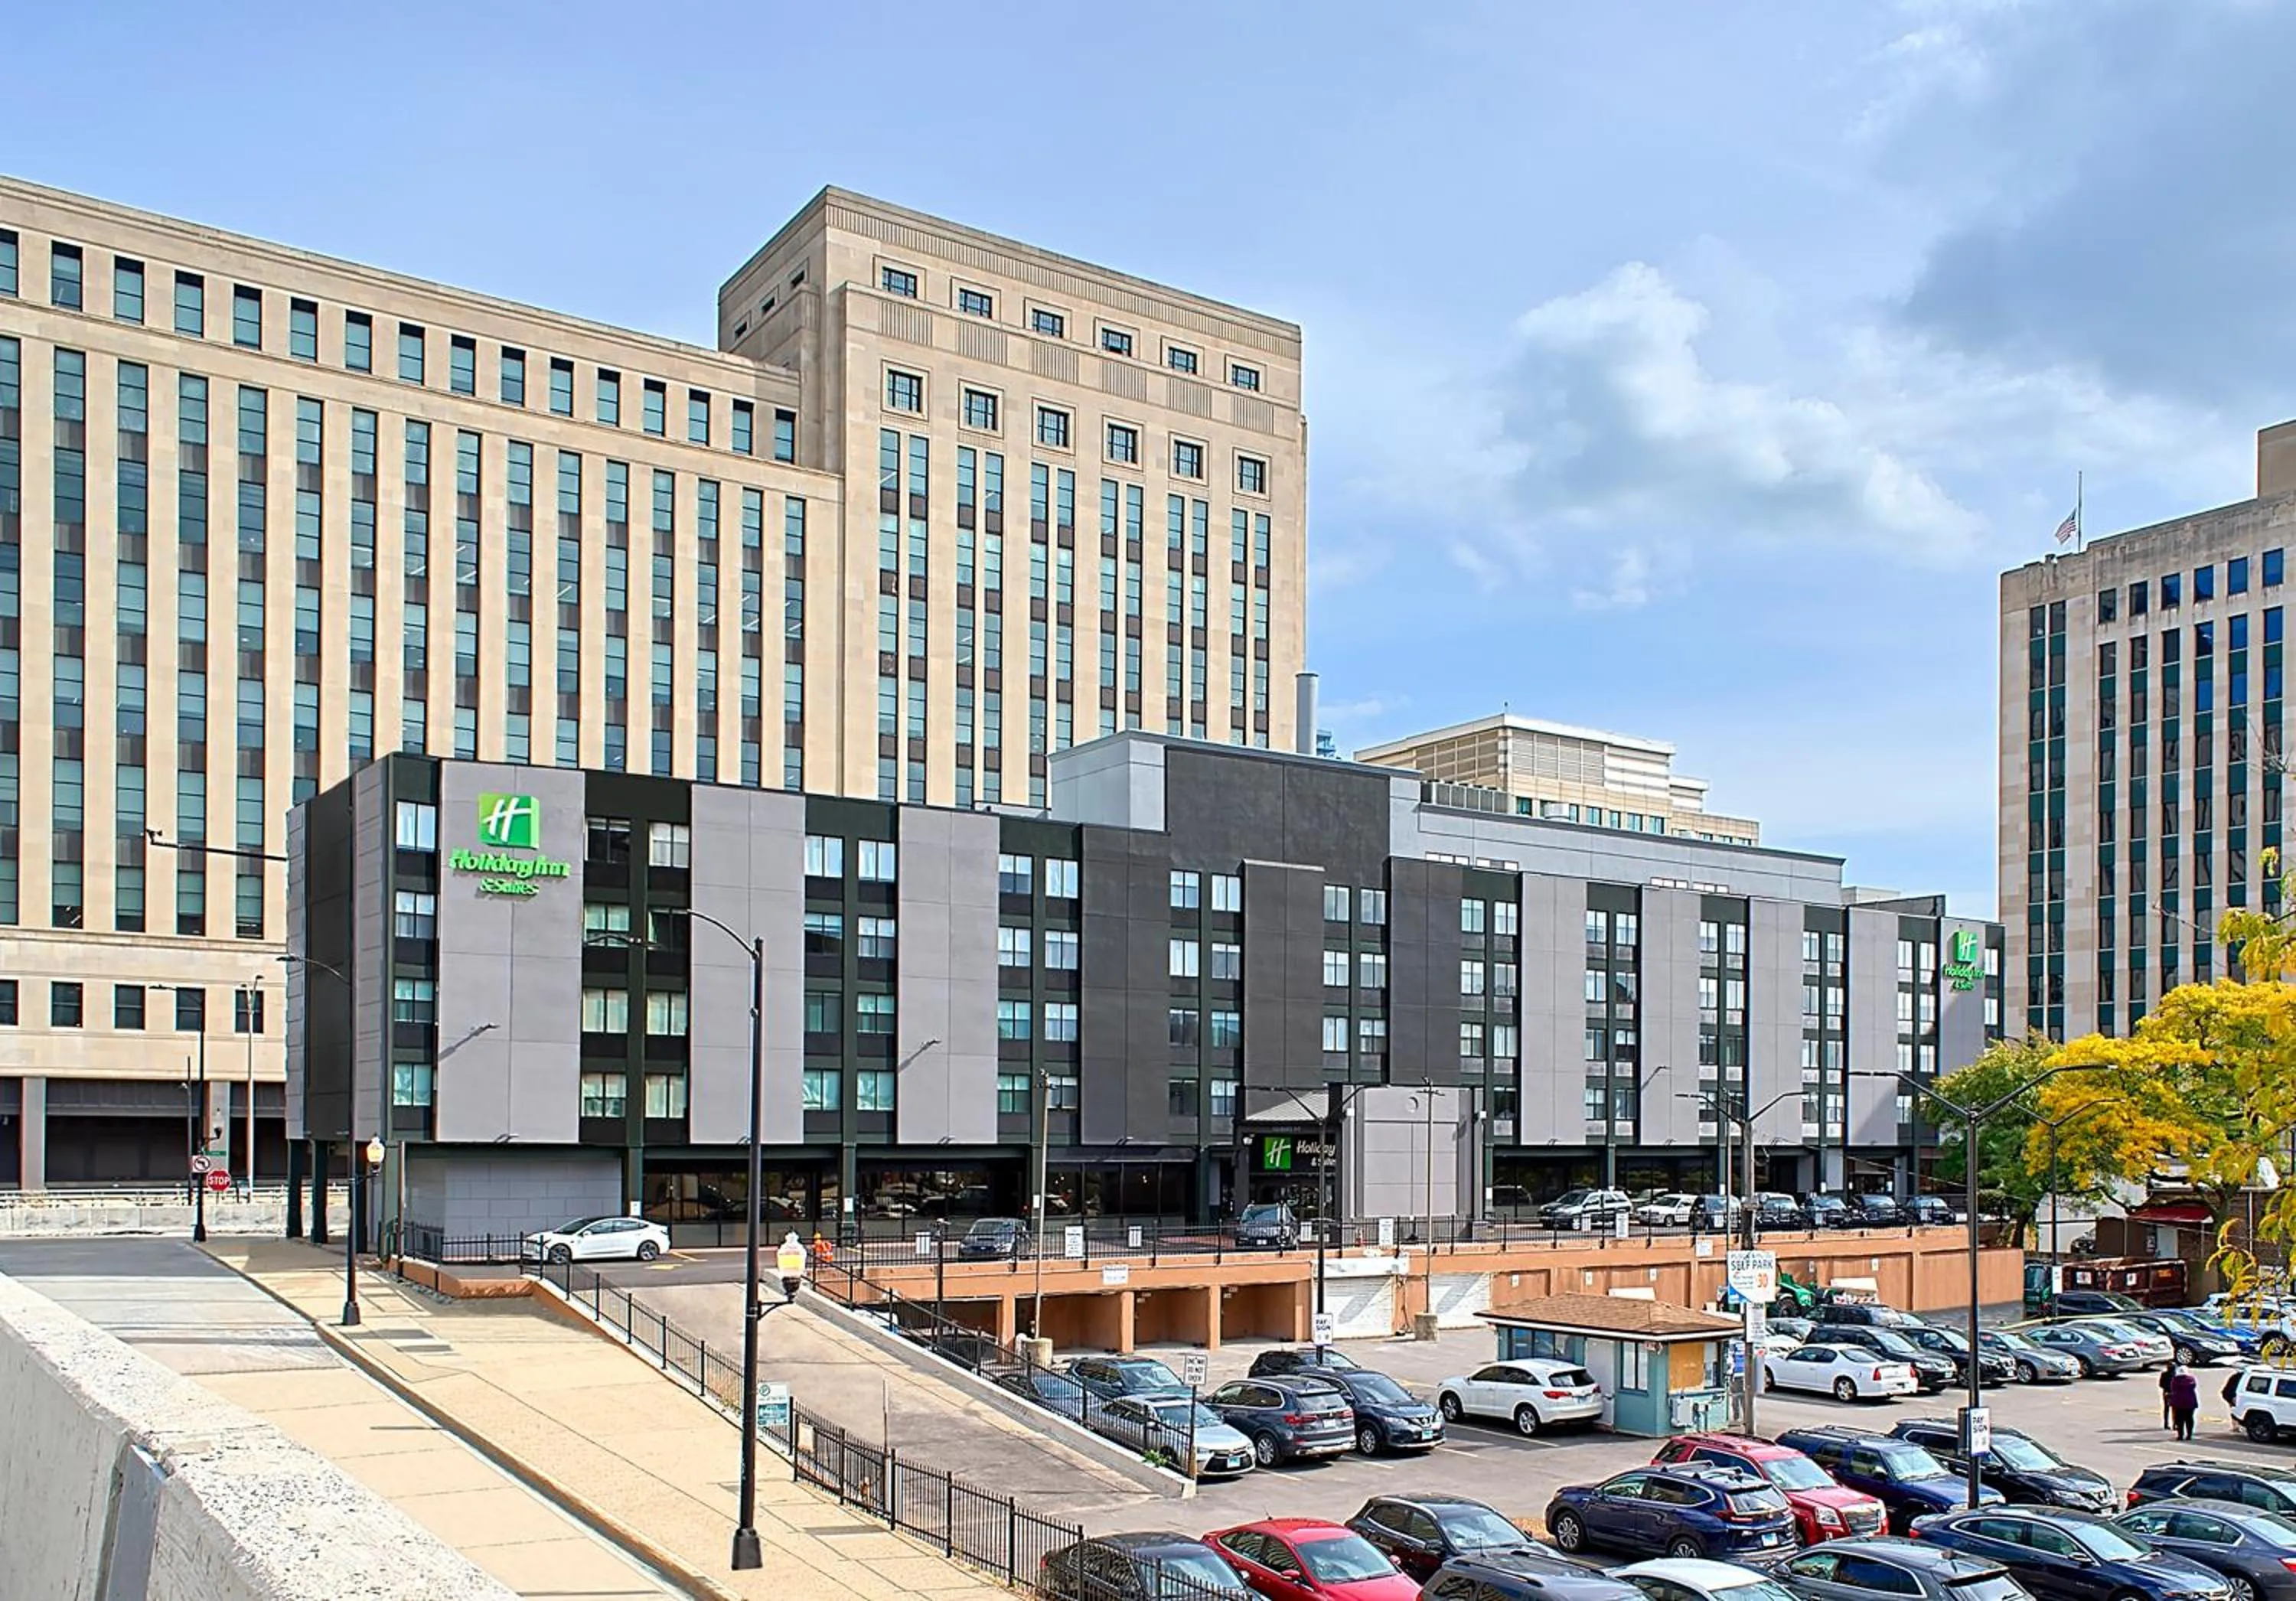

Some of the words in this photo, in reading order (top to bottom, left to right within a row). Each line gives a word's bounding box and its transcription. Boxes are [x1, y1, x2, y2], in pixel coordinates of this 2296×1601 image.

[448, 848, 536, 879] Holiday
[536, 855, 571, 877] Inn
[208, 1175, 230, 1185] STOP
[1730, 1260, 1750, 1271] SELF
[1752, 1259, 1773, 1270] PARK
